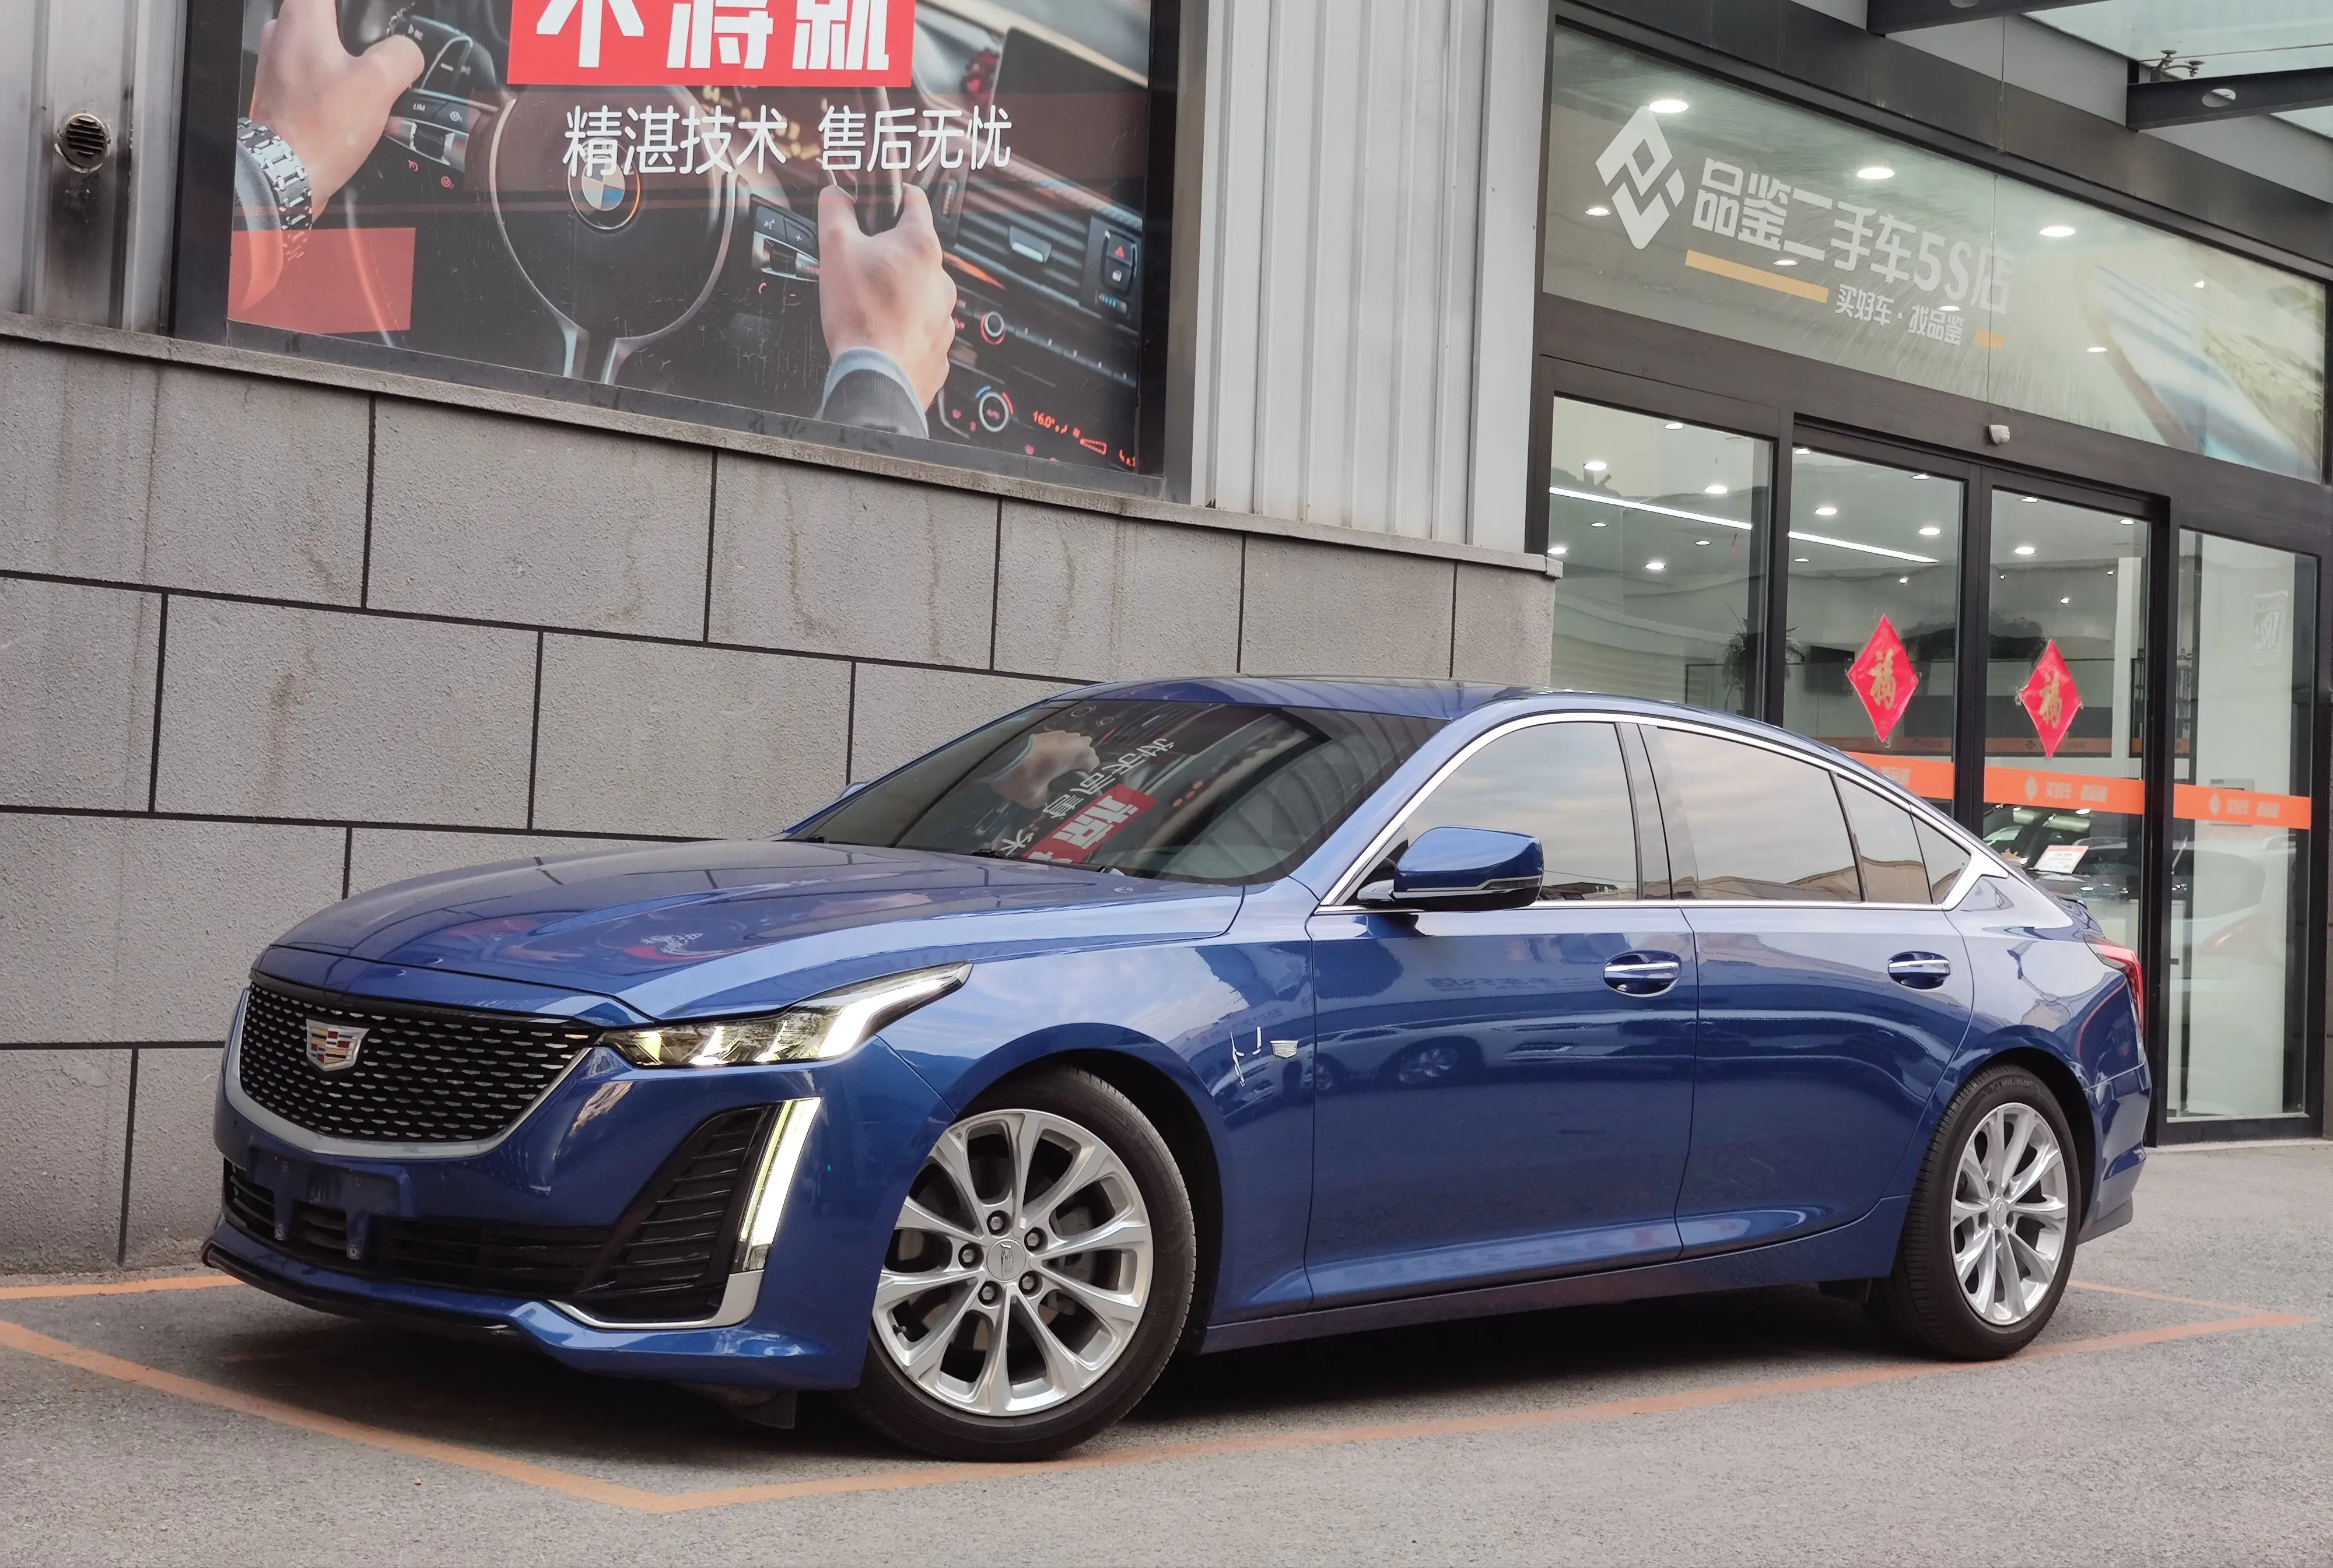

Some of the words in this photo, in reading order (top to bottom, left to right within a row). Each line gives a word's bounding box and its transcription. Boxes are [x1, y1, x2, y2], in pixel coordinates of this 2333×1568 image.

[562, 104, 789, 177] 精湛技术
[818, 104, 1013, 173] 售后无忧
[1691, 157, 2015, 315] 品鉴二手车5S店
[1869, 648, 1897, 710] 福
[2039, 671, 2063, 729] 福
